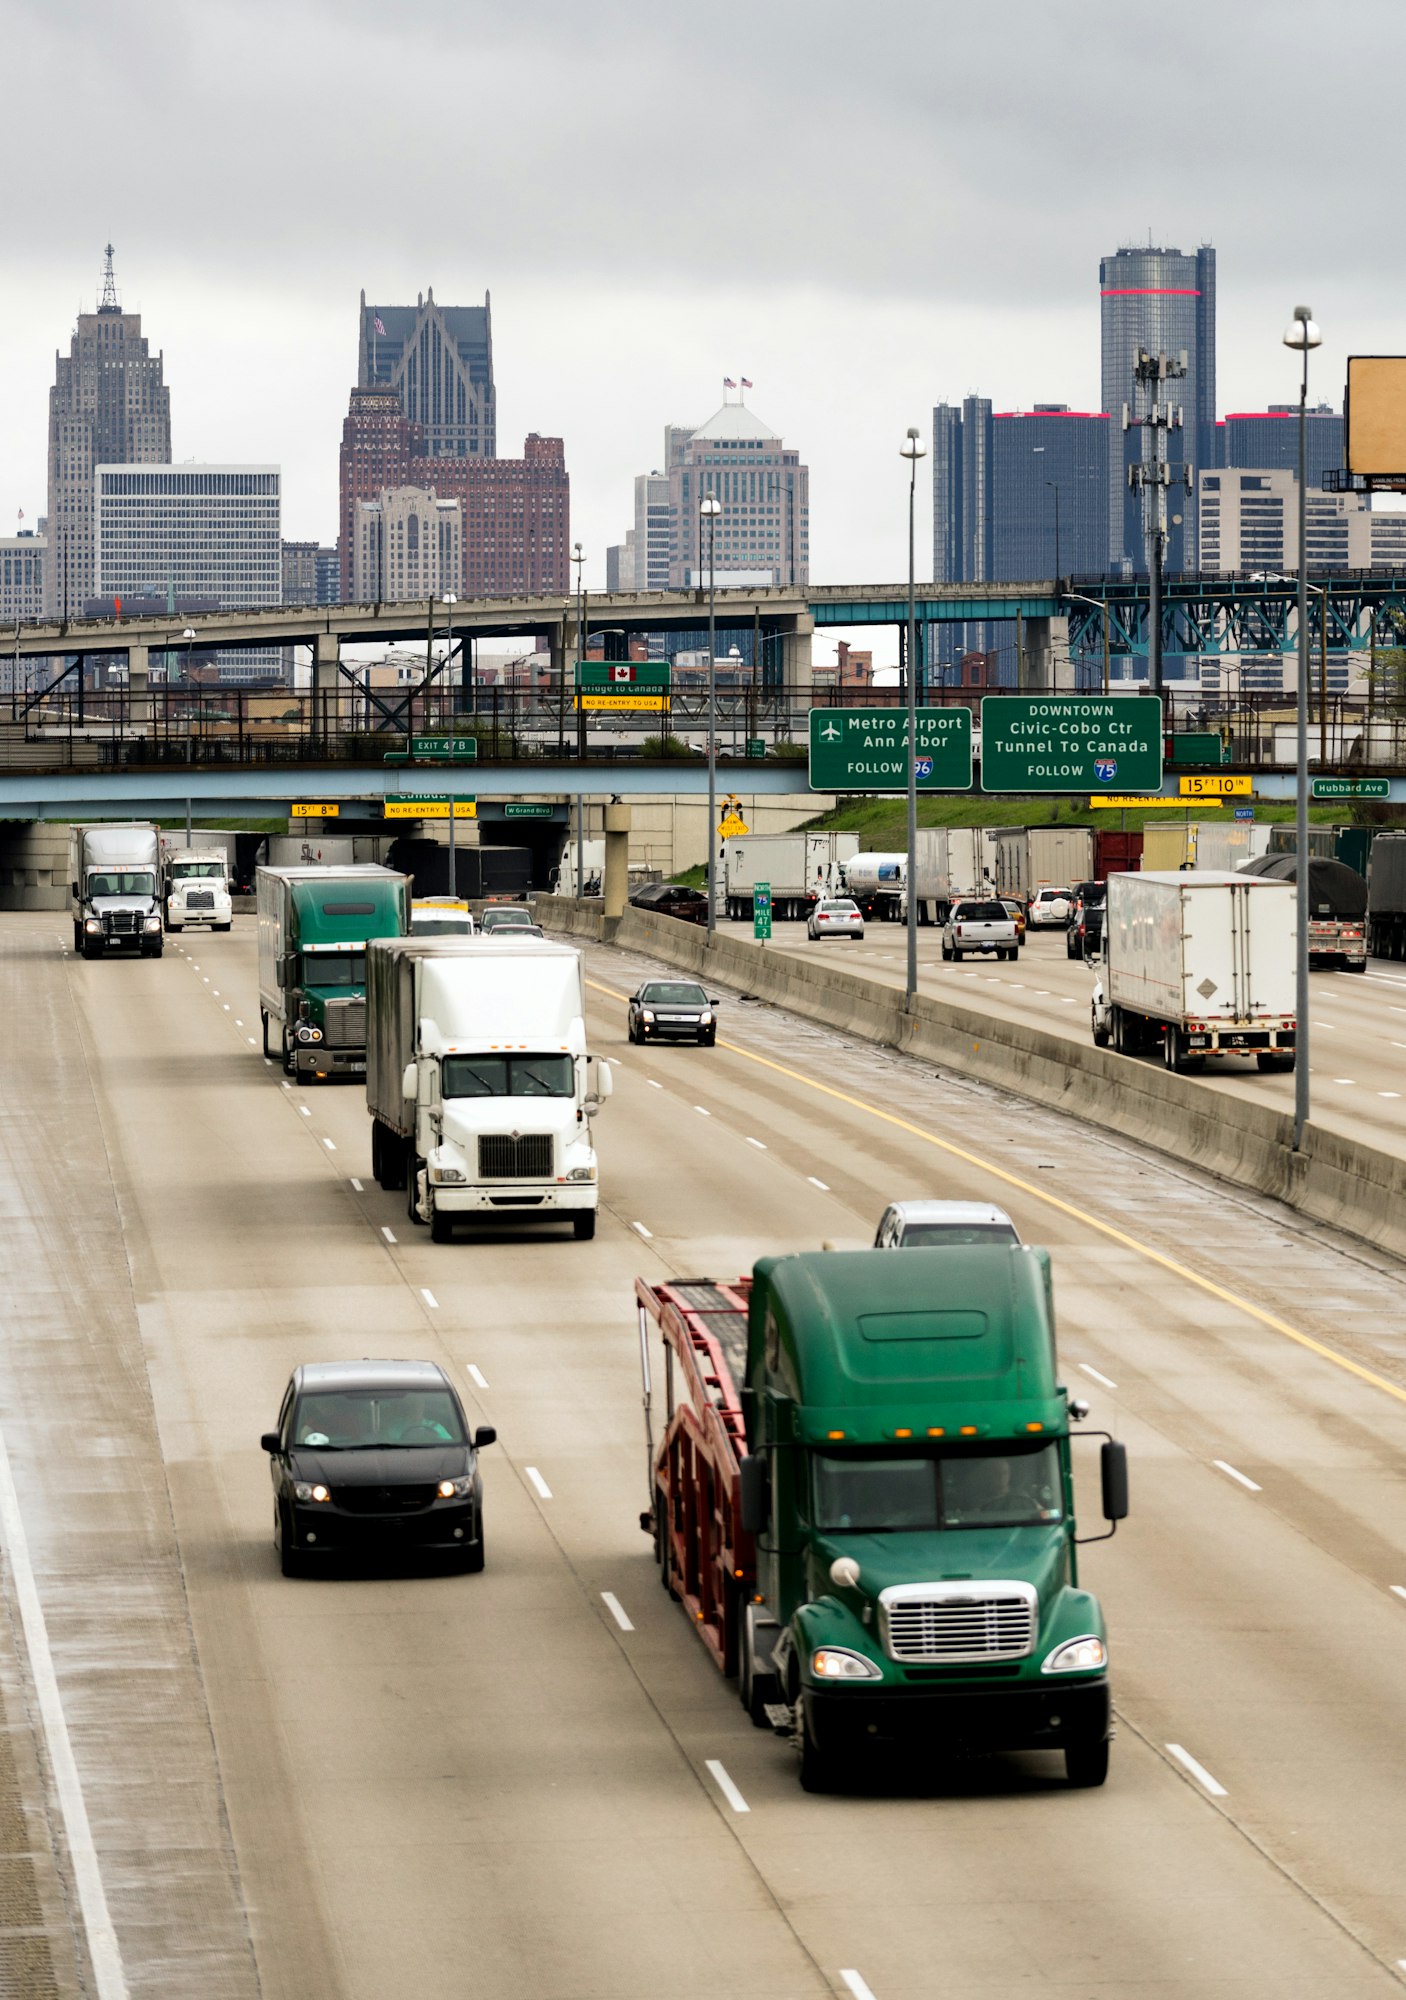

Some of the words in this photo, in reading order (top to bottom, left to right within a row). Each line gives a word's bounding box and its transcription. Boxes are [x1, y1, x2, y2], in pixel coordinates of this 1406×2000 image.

[581, 685, 612, 694] Bridge
[1029, 705, 1114, 716] DOWNTOWN
[849, 718, 896, 730] Metro
[902, 717, 962, 732] Airport
[1010, 722, 1101, 734] Civic-Cobo
[1108, 722, 1132, 734] Ctr
[863, 736, 895, 747] Ann
[995, 740, 1052, 752] Tunnel
[1060, 740, 1080, 752] To
[1087, 740, 1148, 752] Canada
[847, 762, 903, 773] FOLLOW
[914, 761, 930, 774] 96
[1027, 765, 1083, 776] FOLLOW
[1096, 764, 1115, 777] 75
[1188, 779, 1203, 792] 15
[1219, 779, 1234, 792] 10
[1319, 784, 1362, 792] Hubbard
[1365, 784, 1383, 792] Ave
[297, 806, 307, 815] 15
[321, 806, 327, 815] 8
[757, 896, 768, 904] 75
[757, 917, 768, 925] 47
